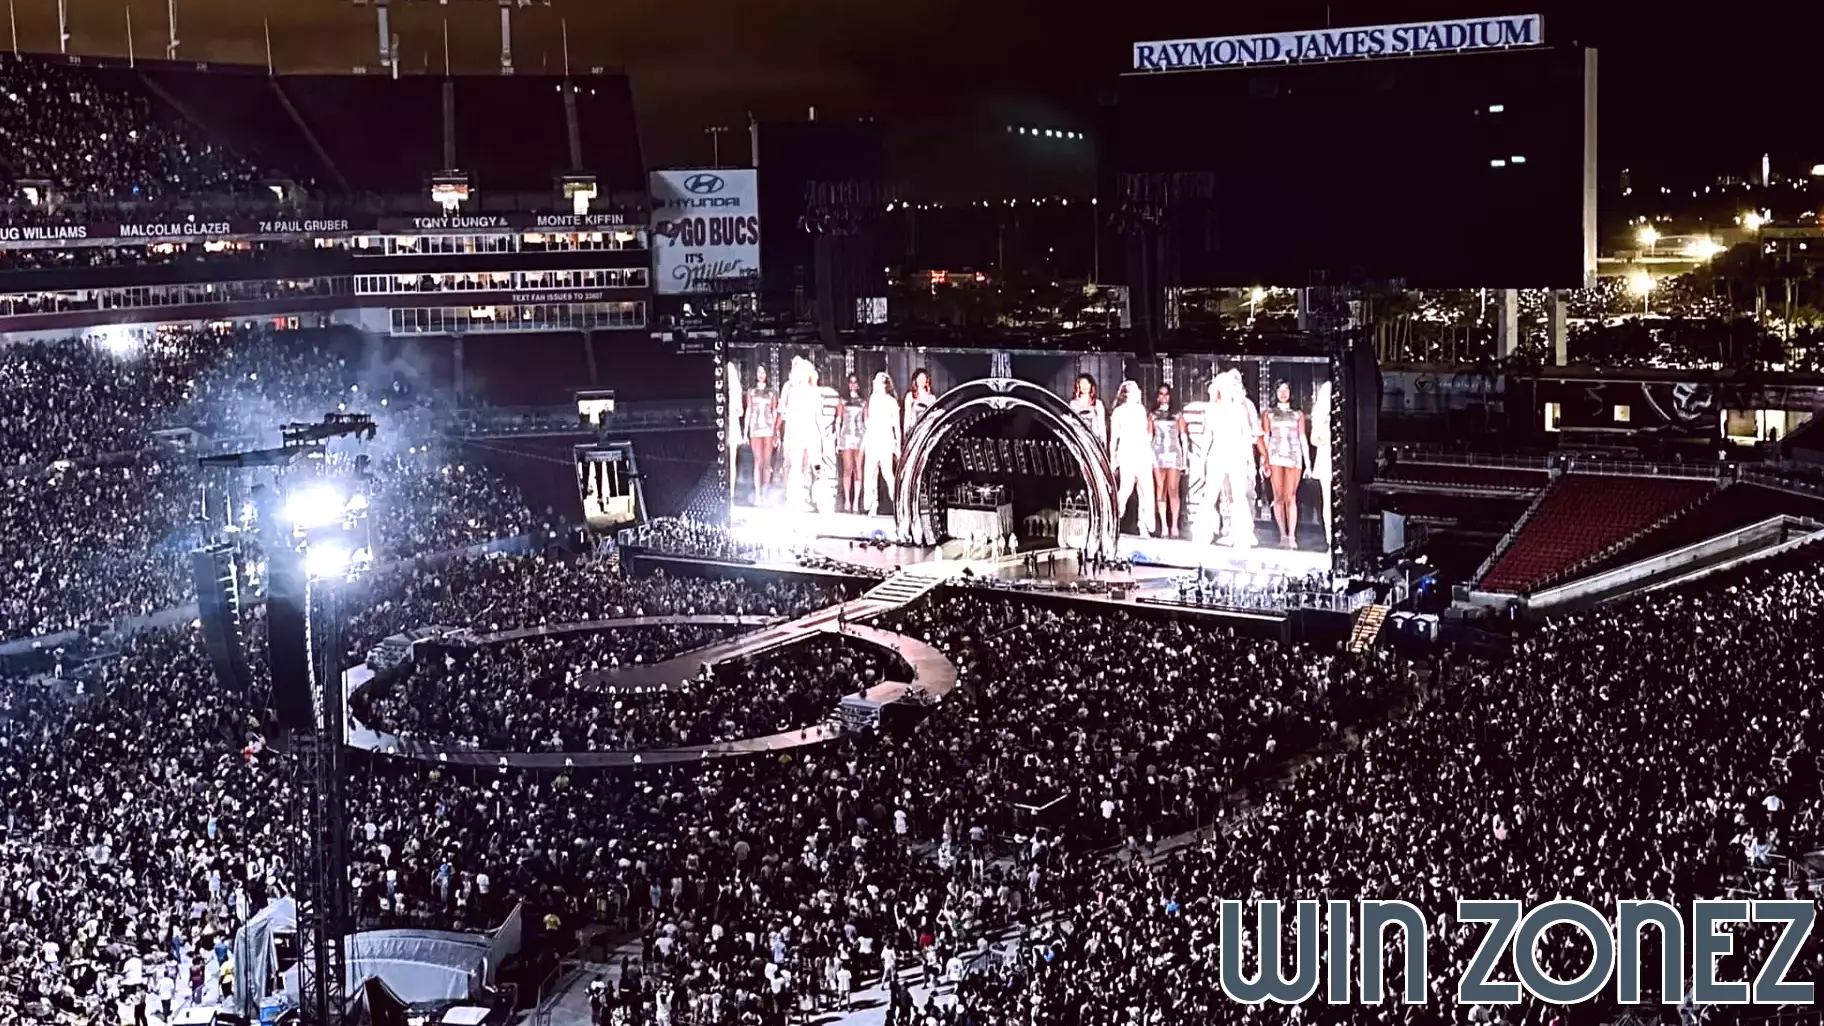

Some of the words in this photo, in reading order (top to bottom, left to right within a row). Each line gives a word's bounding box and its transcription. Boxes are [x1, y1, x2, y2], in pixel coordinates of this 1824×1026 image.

[1137, 36, 1281, 69] RAYMOND
[1285, 29, 1385, 58] JAMES
[1391, 18, 1534, 52] STADIUM
[669, 197, 741, 207] HYUNDAI
[259, 222, 271, 232] 74
[274, 221, 301, 231] PAUL
[304, 219, 348, 231] GRUBER
[413, 217, 448, 228] TONY
[452, 216, 497, 227] DUNGY
[537, 215, 580, 226] MONTE
[585, 214, 624, 225] KIFFIN
[0, 227, 19, 240] UG
[23, 226, 87, 239] WILLIAMS
[120, 224, 181, 236] MALCOLM
[184, 222, 230, 235] GLAZER
[681, 217, 706, 247] GO
[709, 216, 758, 246] BUCS
[685, 253, 704, 263] IT'S
[672, 258, 741, 290] Miller
[573, 292, 584, 300] TO
